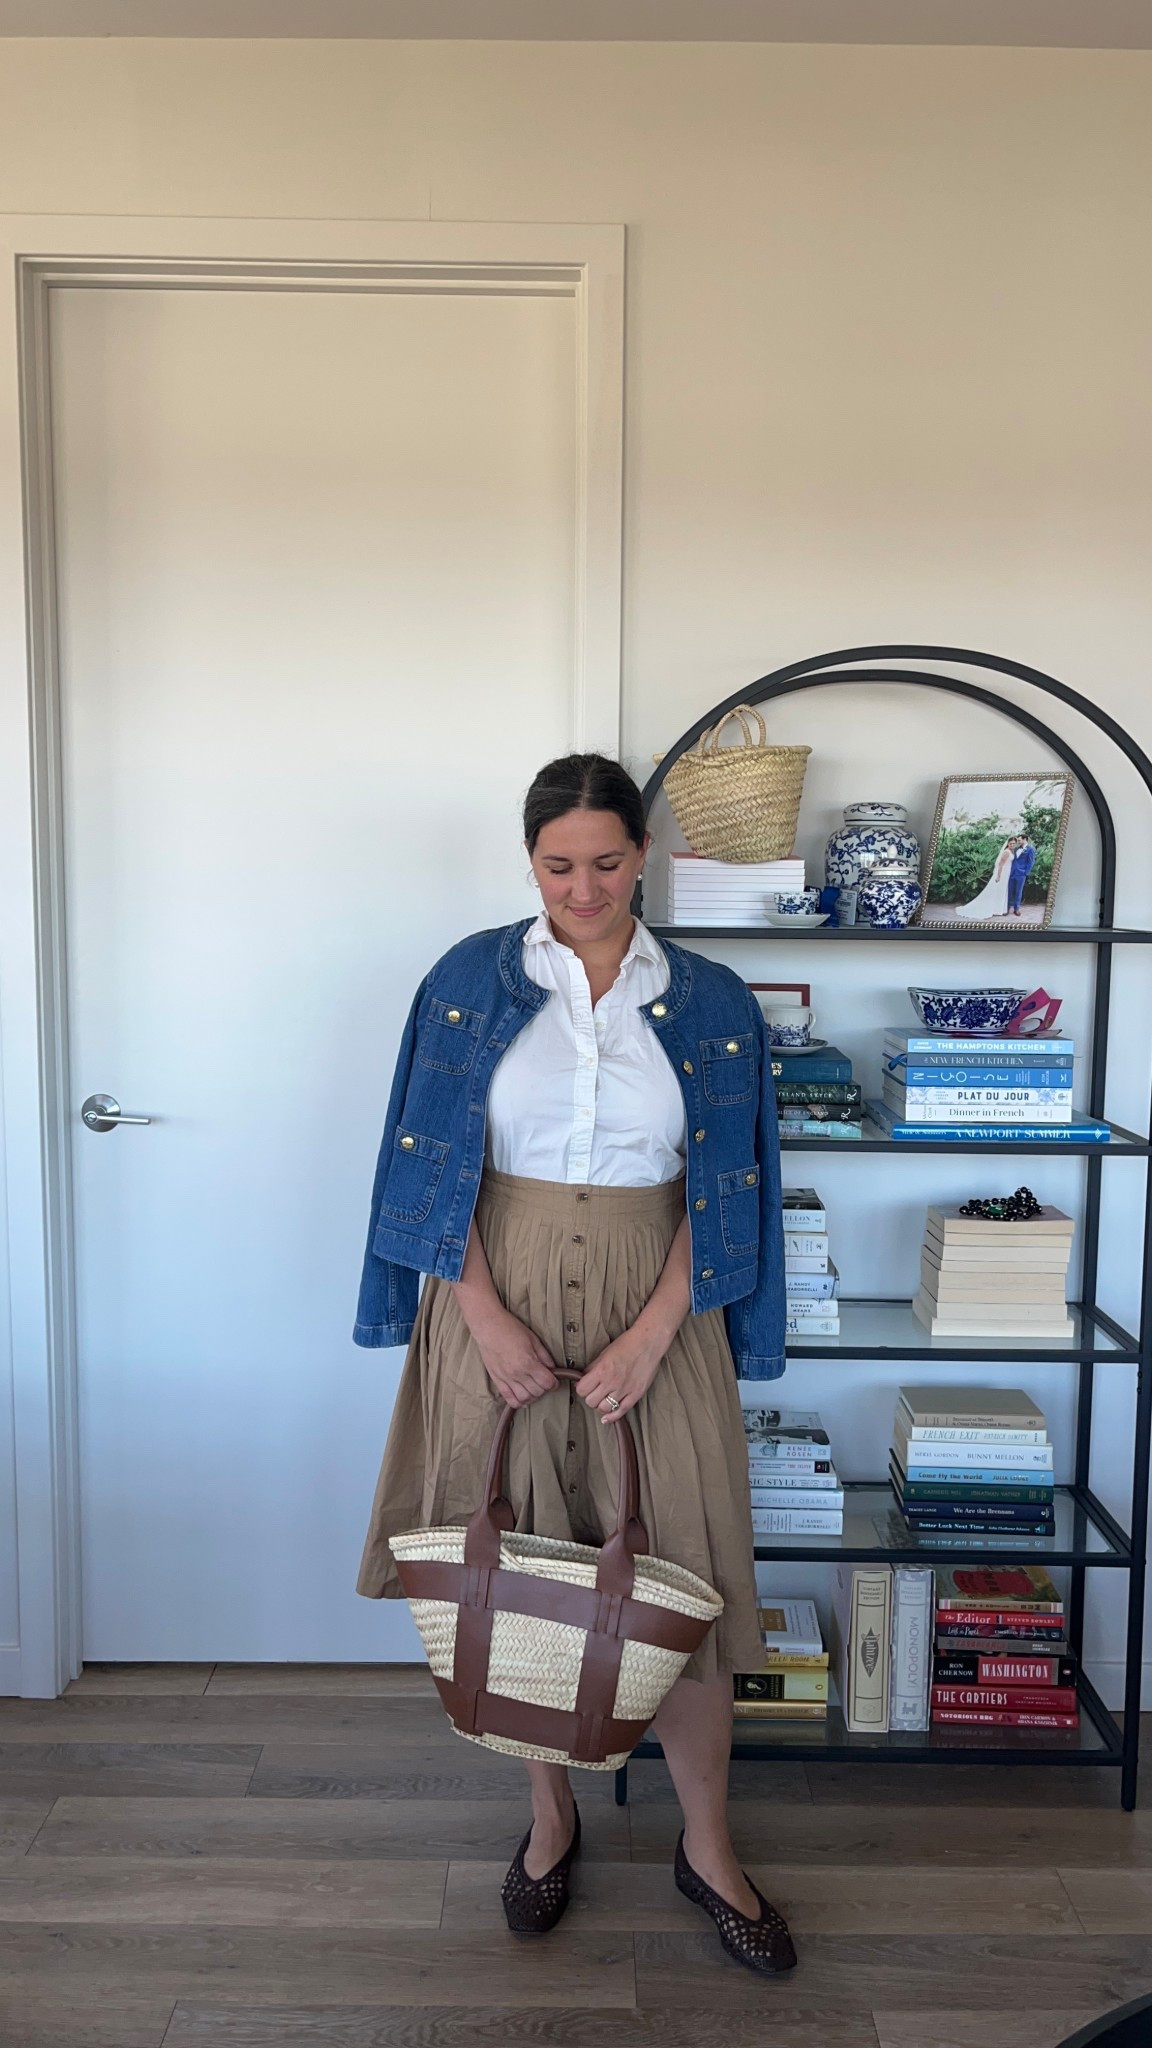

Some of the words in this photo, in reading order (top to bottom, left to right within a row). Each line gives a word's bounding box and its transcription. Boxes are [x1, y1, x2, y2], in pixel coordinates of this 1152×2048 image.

[936, 1042, 953, 1050] THE
[957, 1042, 1005, 1050] HAMPTONS
[1007, 1043, 1046, 1051] KITCHEN
[930, 1056, 948, 1064] NEW
[951, 1056, 984, 1064] FRENCH
[987, 1056, 1024, 1065] KITCHEN
[957, 1091, 982, 1101] PLAT
[986, 1091, 999, 1101] DU
[1004, 1091, 1030, 1101] JOUR
[949, 1108, 980, 1116] Dinner
[982, 1108, 991, 1116] in
[993, 1108, 1024, 1117] French
[955, 1128, 962, 1138] A
[965, 1128, 1020, 1138] NEWPORT
[1024, 1129, 1071, 1139] SUMMER
[922, 1430, 956, 1440] FRENCH
[960, 1431, 981, 1440] EXIT
[938, 1472, 947, 1480] Fly
[766, 1478, 797, 1487] STYLE
[956, 1613, 991, 1624] Editor
[982, 1664, 1048, 1678] WASHINGTON
[936, 1690, 956, 1703] THE
[960, 1691, 1008, 1705] CARTIERS
